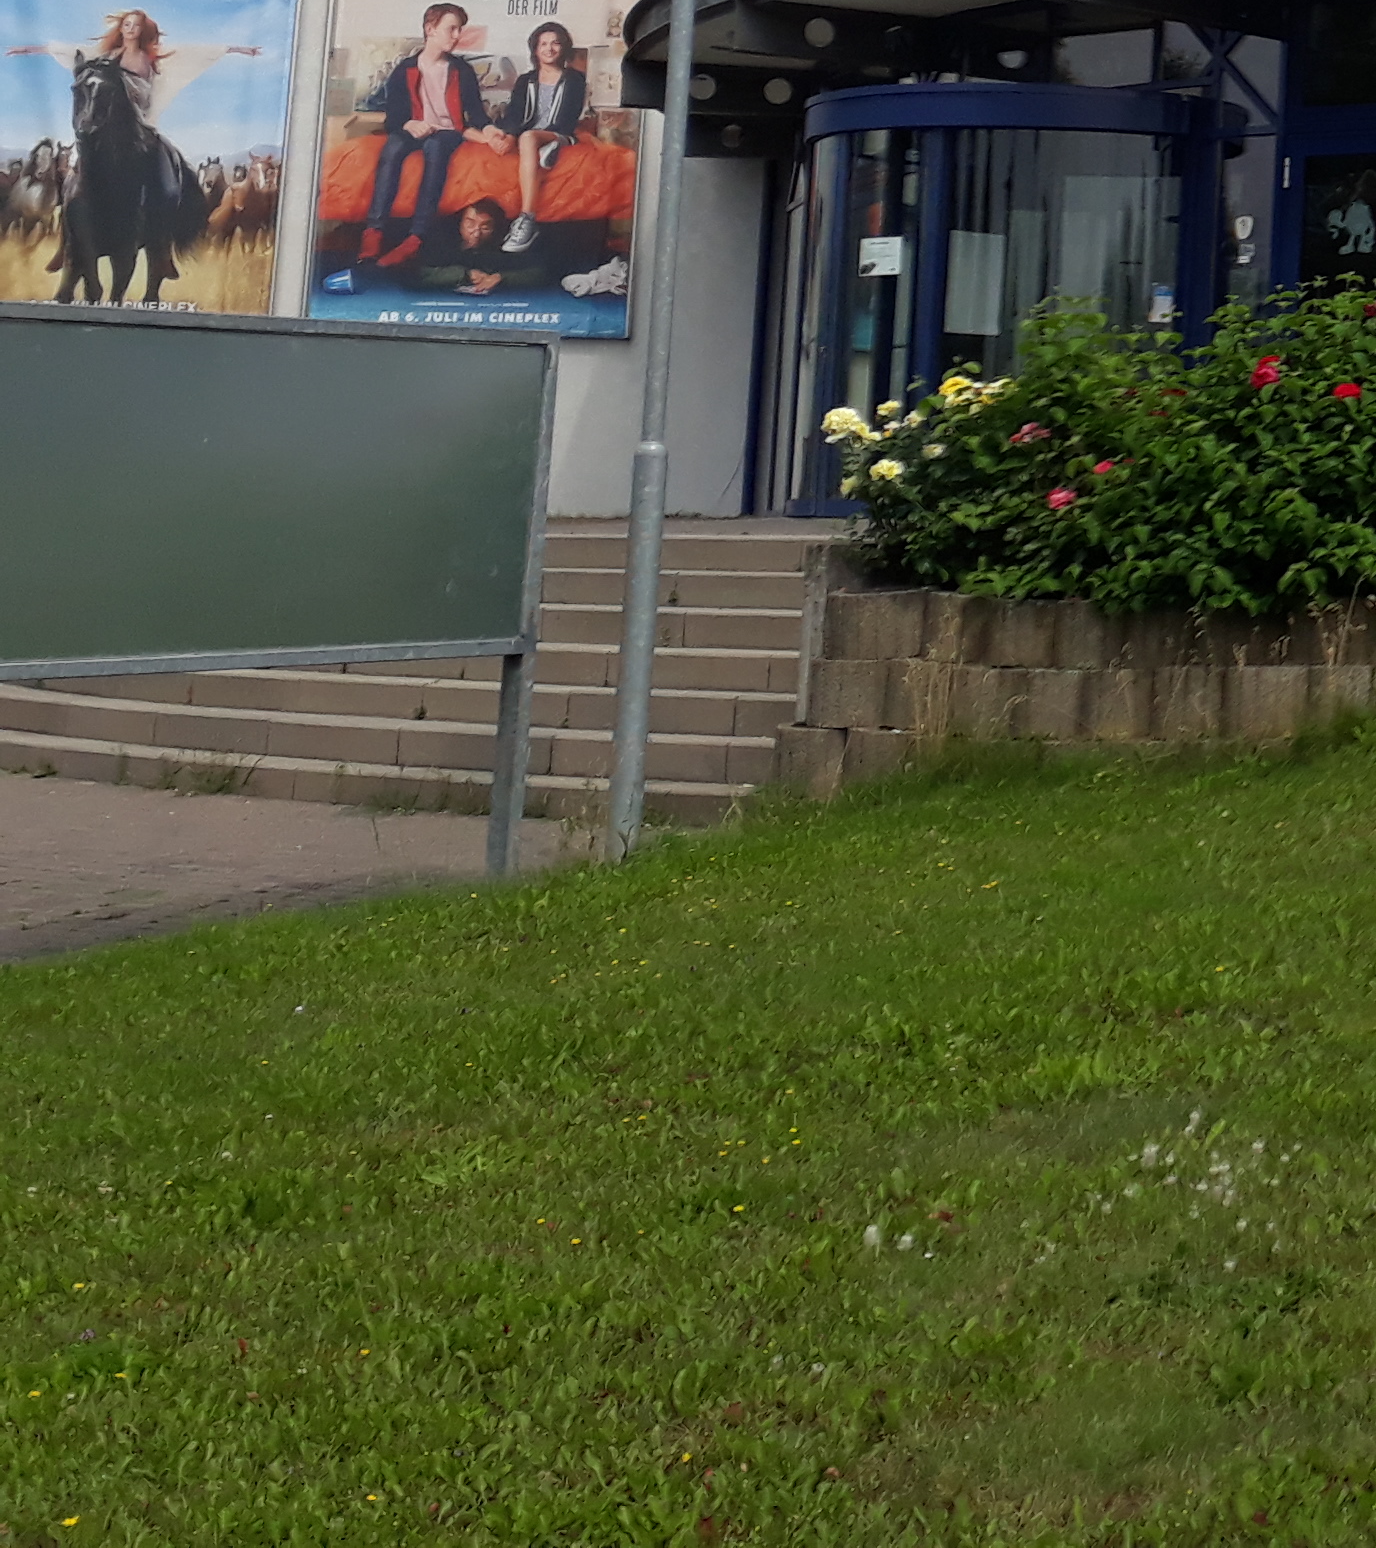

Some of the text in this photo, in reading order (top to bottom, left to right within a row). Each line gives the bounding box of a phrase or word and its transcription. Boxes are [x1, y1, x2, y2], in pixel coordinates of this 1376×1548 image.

[507, 0, 558, 16] DER FILM
[378, 311, 560, 324] AB 6. JULI IM CINEPLEX
